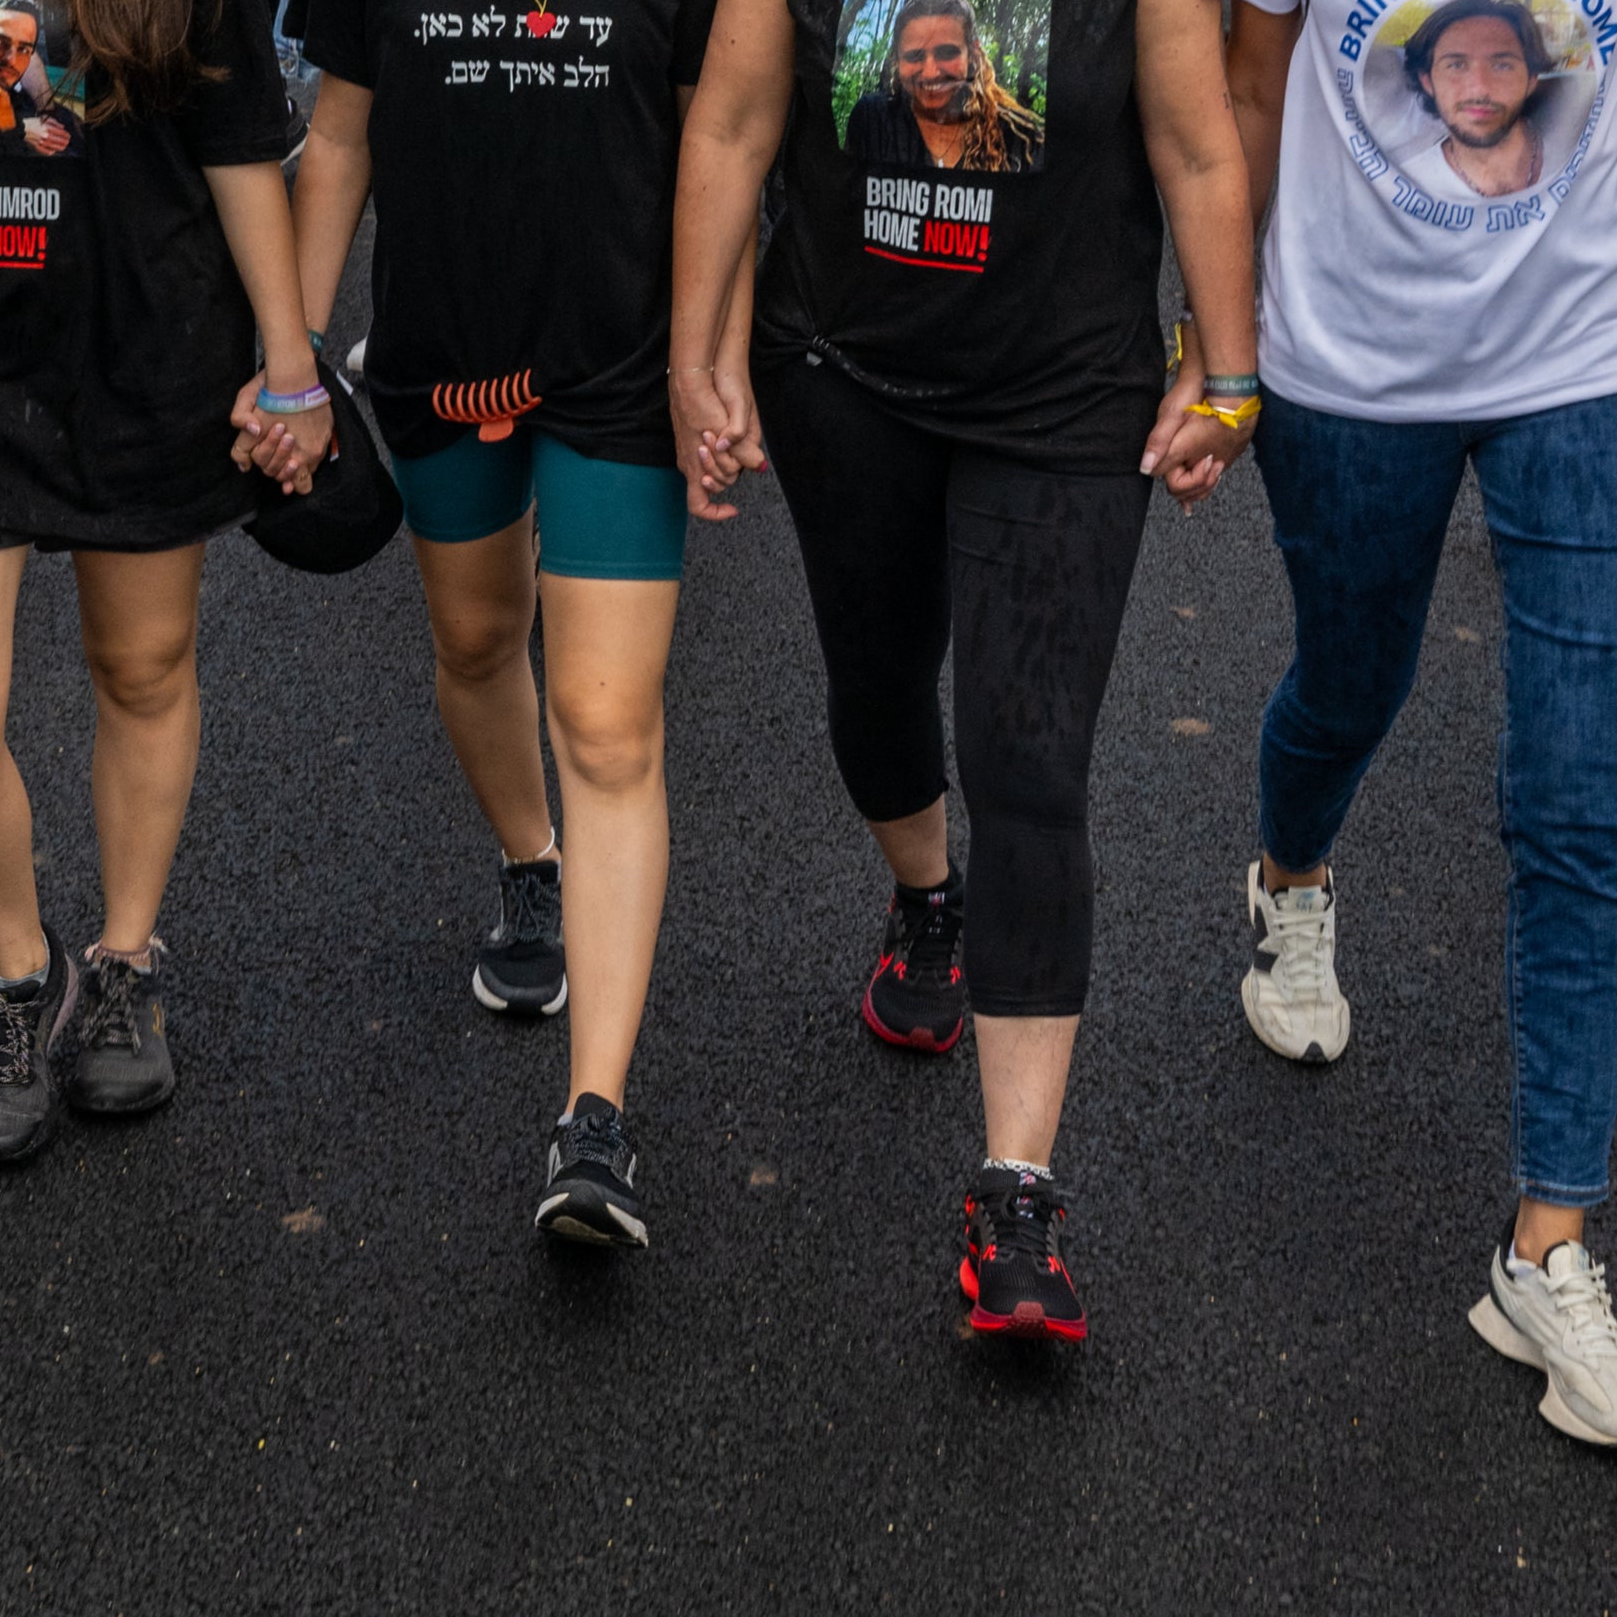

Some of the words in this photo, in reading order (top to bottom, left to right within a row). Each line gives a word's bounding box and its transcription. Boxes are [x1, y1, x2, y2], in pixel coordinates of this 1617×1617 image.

[413, 11, 464, 46] כאן.
[472, 3, 507, 38] לא
[579, 14, 613, 48] עד
[444, 59, 491, 85] שם.
[499, 60, 556, 93] איתך
[563, 55, 610, 88] הלב
[866, 175, 931, 217] BRING
[933, 183, 994, 223] ROMI
[1391, 175, 1474, 231] עומר
[864, 208, 921, 252] HOME
[923, 219, 990, 262] NOW!
